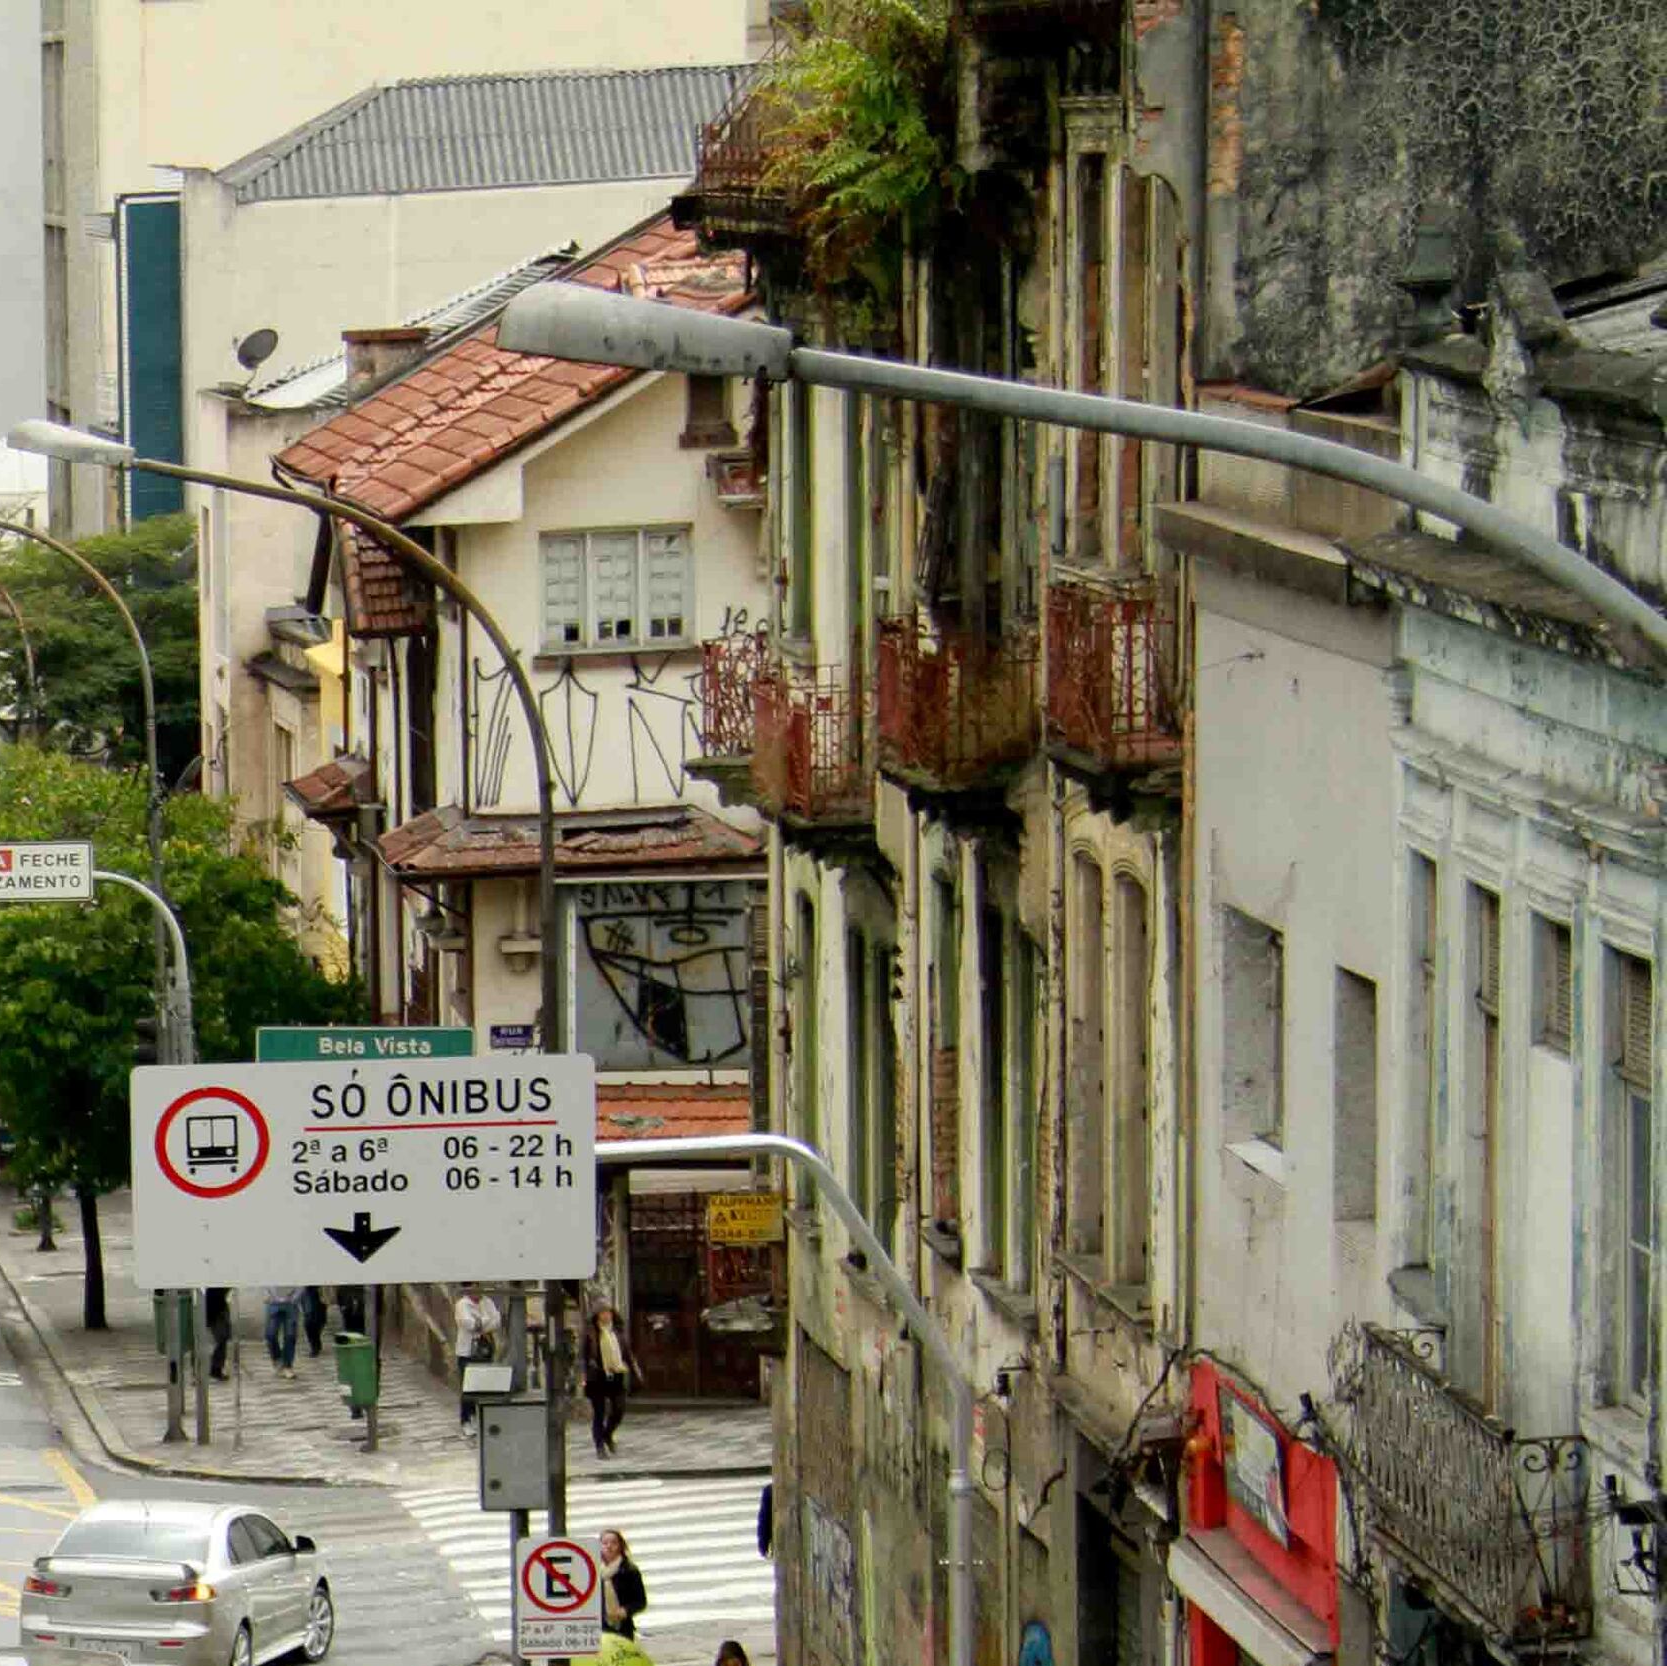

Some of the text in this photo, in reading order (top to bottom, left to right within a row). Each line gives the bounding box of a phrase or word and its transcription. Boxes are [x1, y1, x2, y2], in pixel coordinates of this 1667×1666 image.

[20, 852, 81, 868] FECHE
[319, 1037, 432, 1057] Bela Vista
[312, 1069, 552, 1119] SÓ ÔNIBUS
[293, 1139, 321, 1163] 2ª
[332, 1144, 347, 1162] a
[359, 1138, 388, 1162] 6ª
[444, 1136, 479, 1160] 06
[509, 1135, 544, 1159] 22
[555, 1134, 572, 1157] h
[294, 1168, 408, 1194] Sábado
[446, 1168, 480, 1190] 06
[509, 1167, 543, 1190] 14
[556, 1166, 573, 1189] h
[546, 1556, 572, 1598] E
